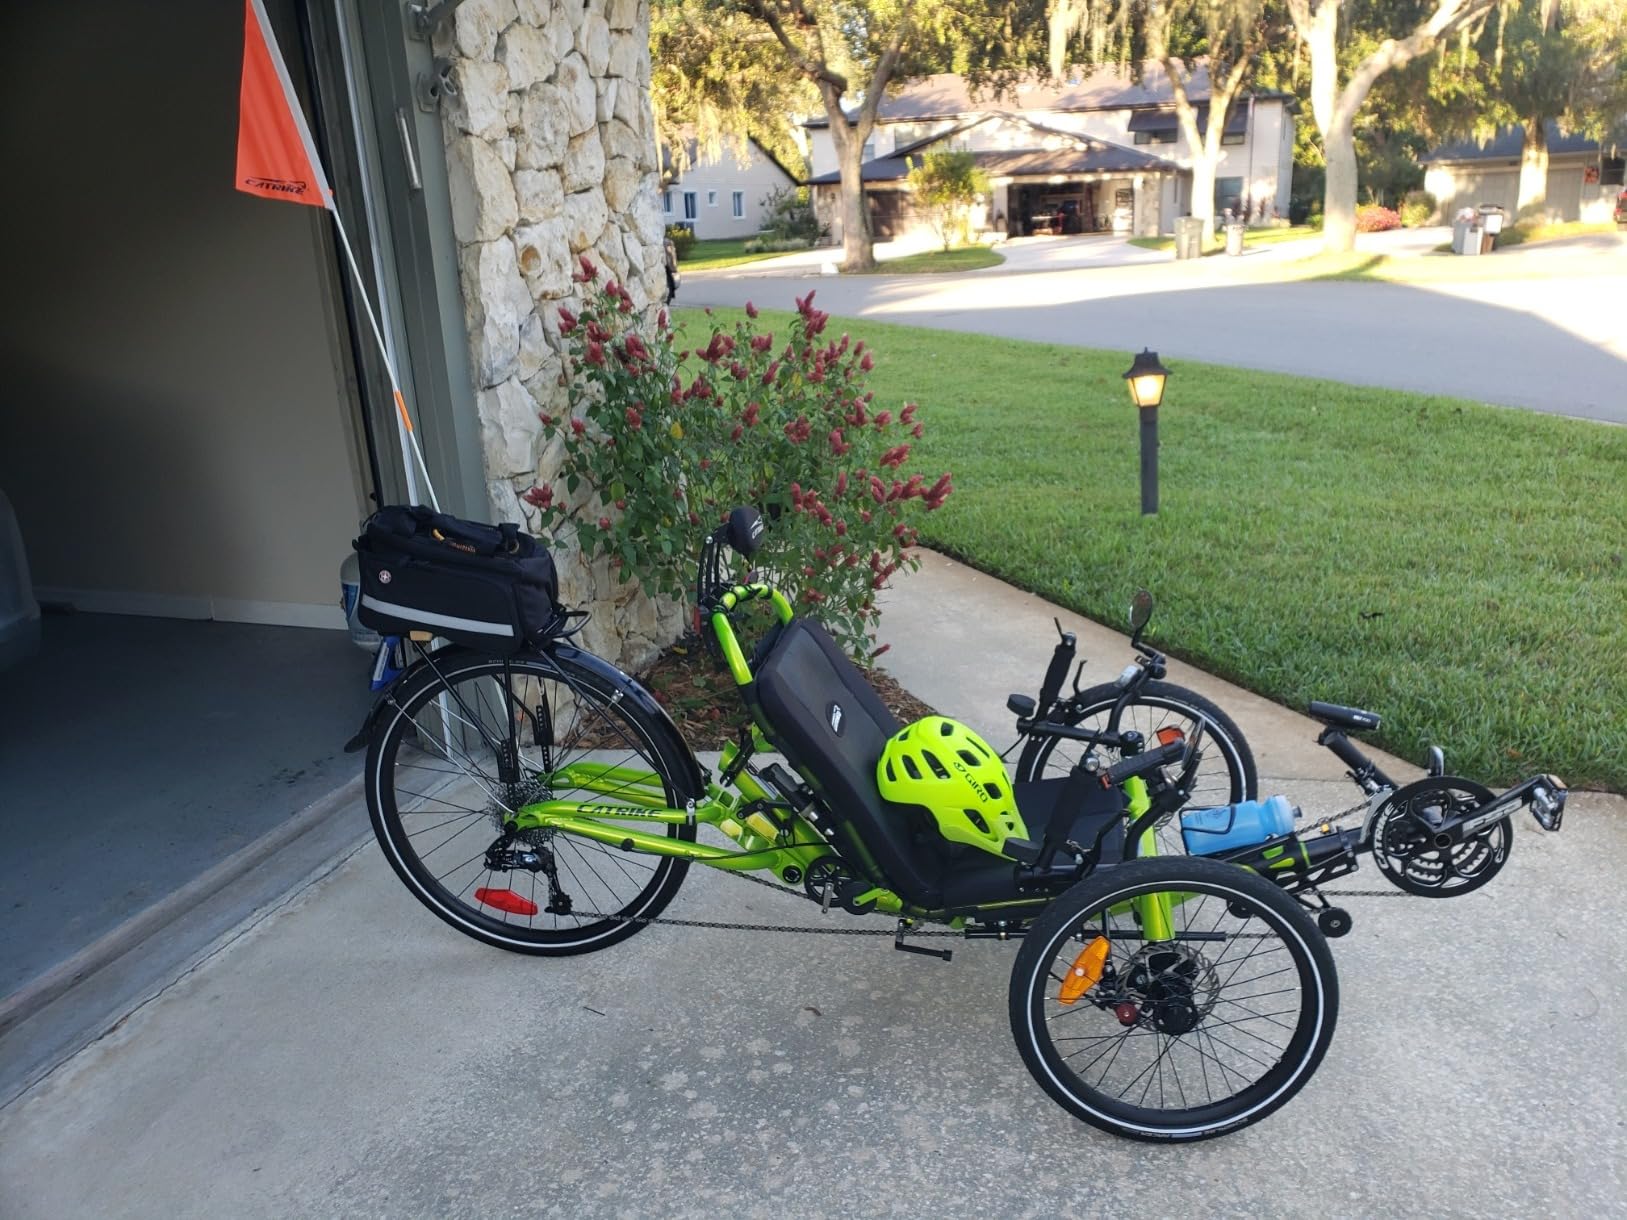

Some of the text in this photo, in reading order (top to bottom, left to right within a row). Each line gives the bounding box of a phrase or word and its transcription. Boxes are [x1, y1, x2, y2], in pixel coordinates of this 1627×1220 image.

[245, 178, 306, 195] CATRIKE
[964, 773, 988, 803] GIRO
[576, 804, 663, 818] CATRIKE
